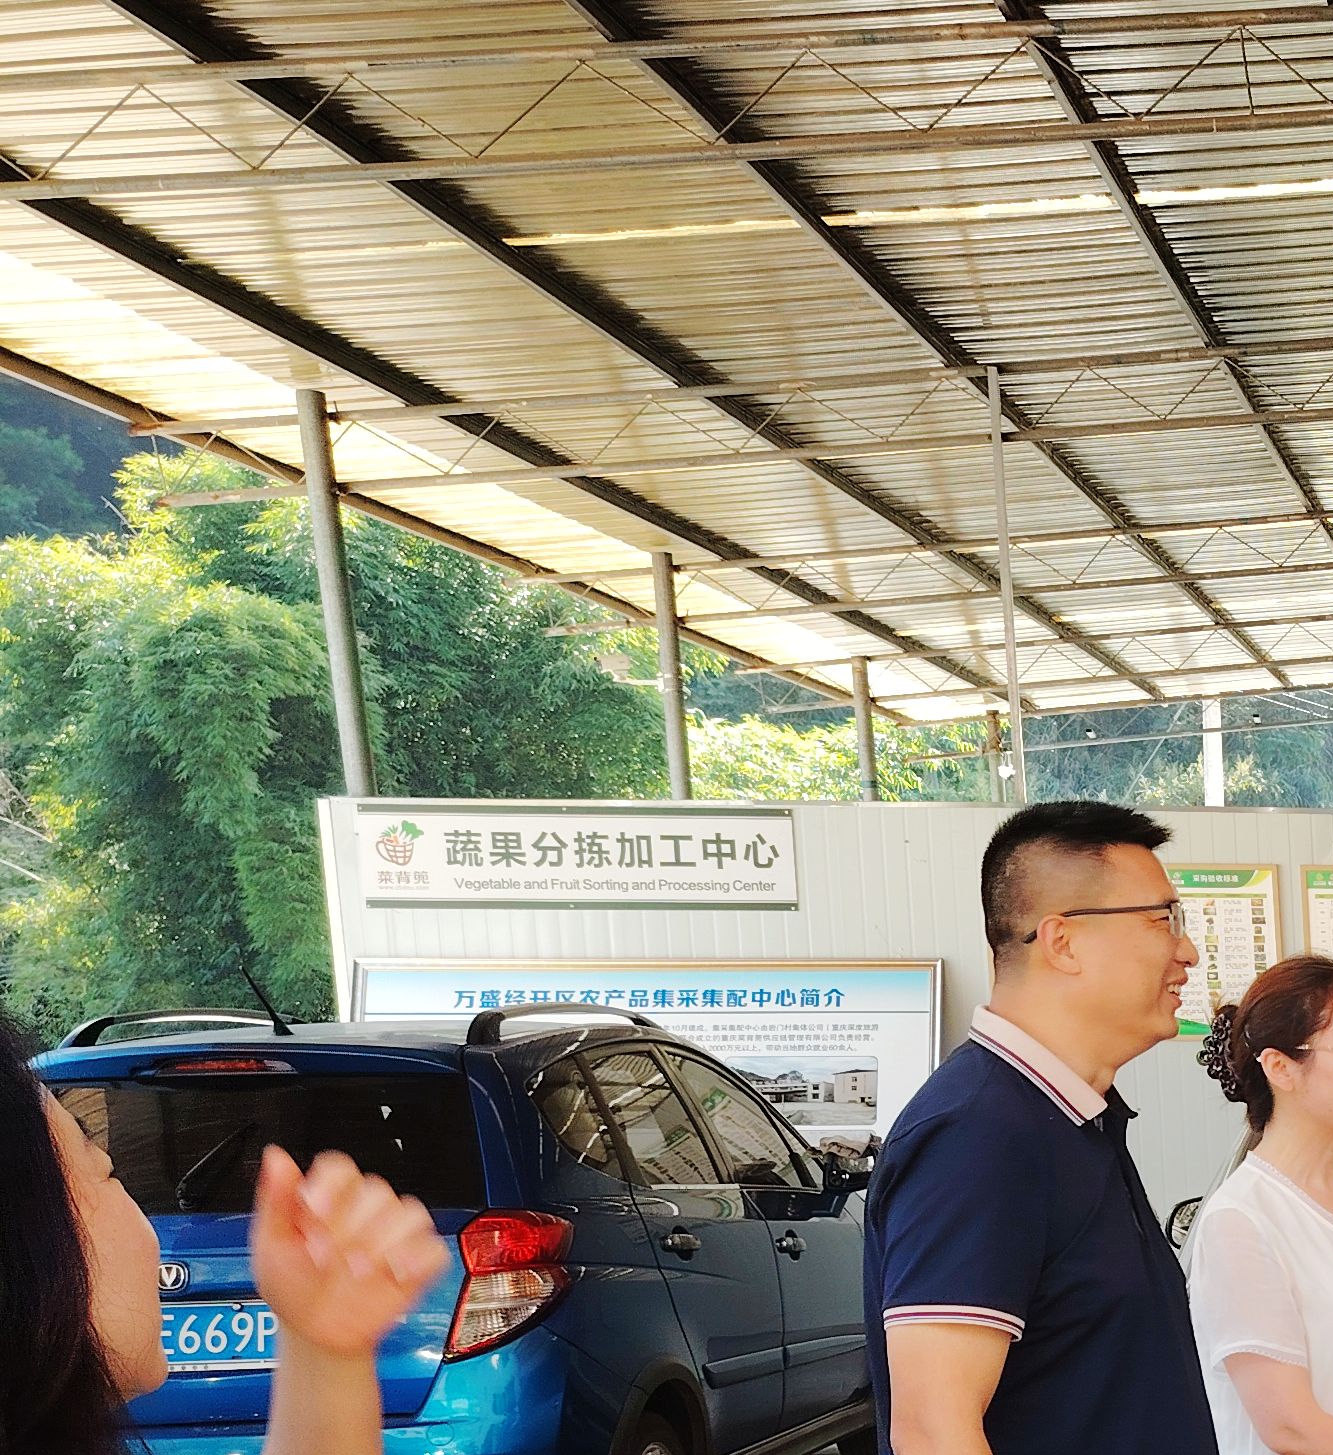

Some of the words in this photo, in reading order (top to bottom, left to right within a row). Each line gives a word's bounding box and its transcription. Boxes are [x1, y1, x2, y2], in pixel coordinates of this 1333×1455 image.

[443, 829, 780, 870] 蔬果分拣加工中心
[454, 877, 521, 892] Vegetable
[524, 878, 548, 890] and
[551, 878, 581, 890] Fruit
[583, 878, 629, 893] Sorting
[632, 880, 656, 891] and
[658, 879, 731, 894] Processing
[733, 880, 777, 892] Center
[453, 988, 845, 1009] 万盛经开区农产品集采集配中心简介
